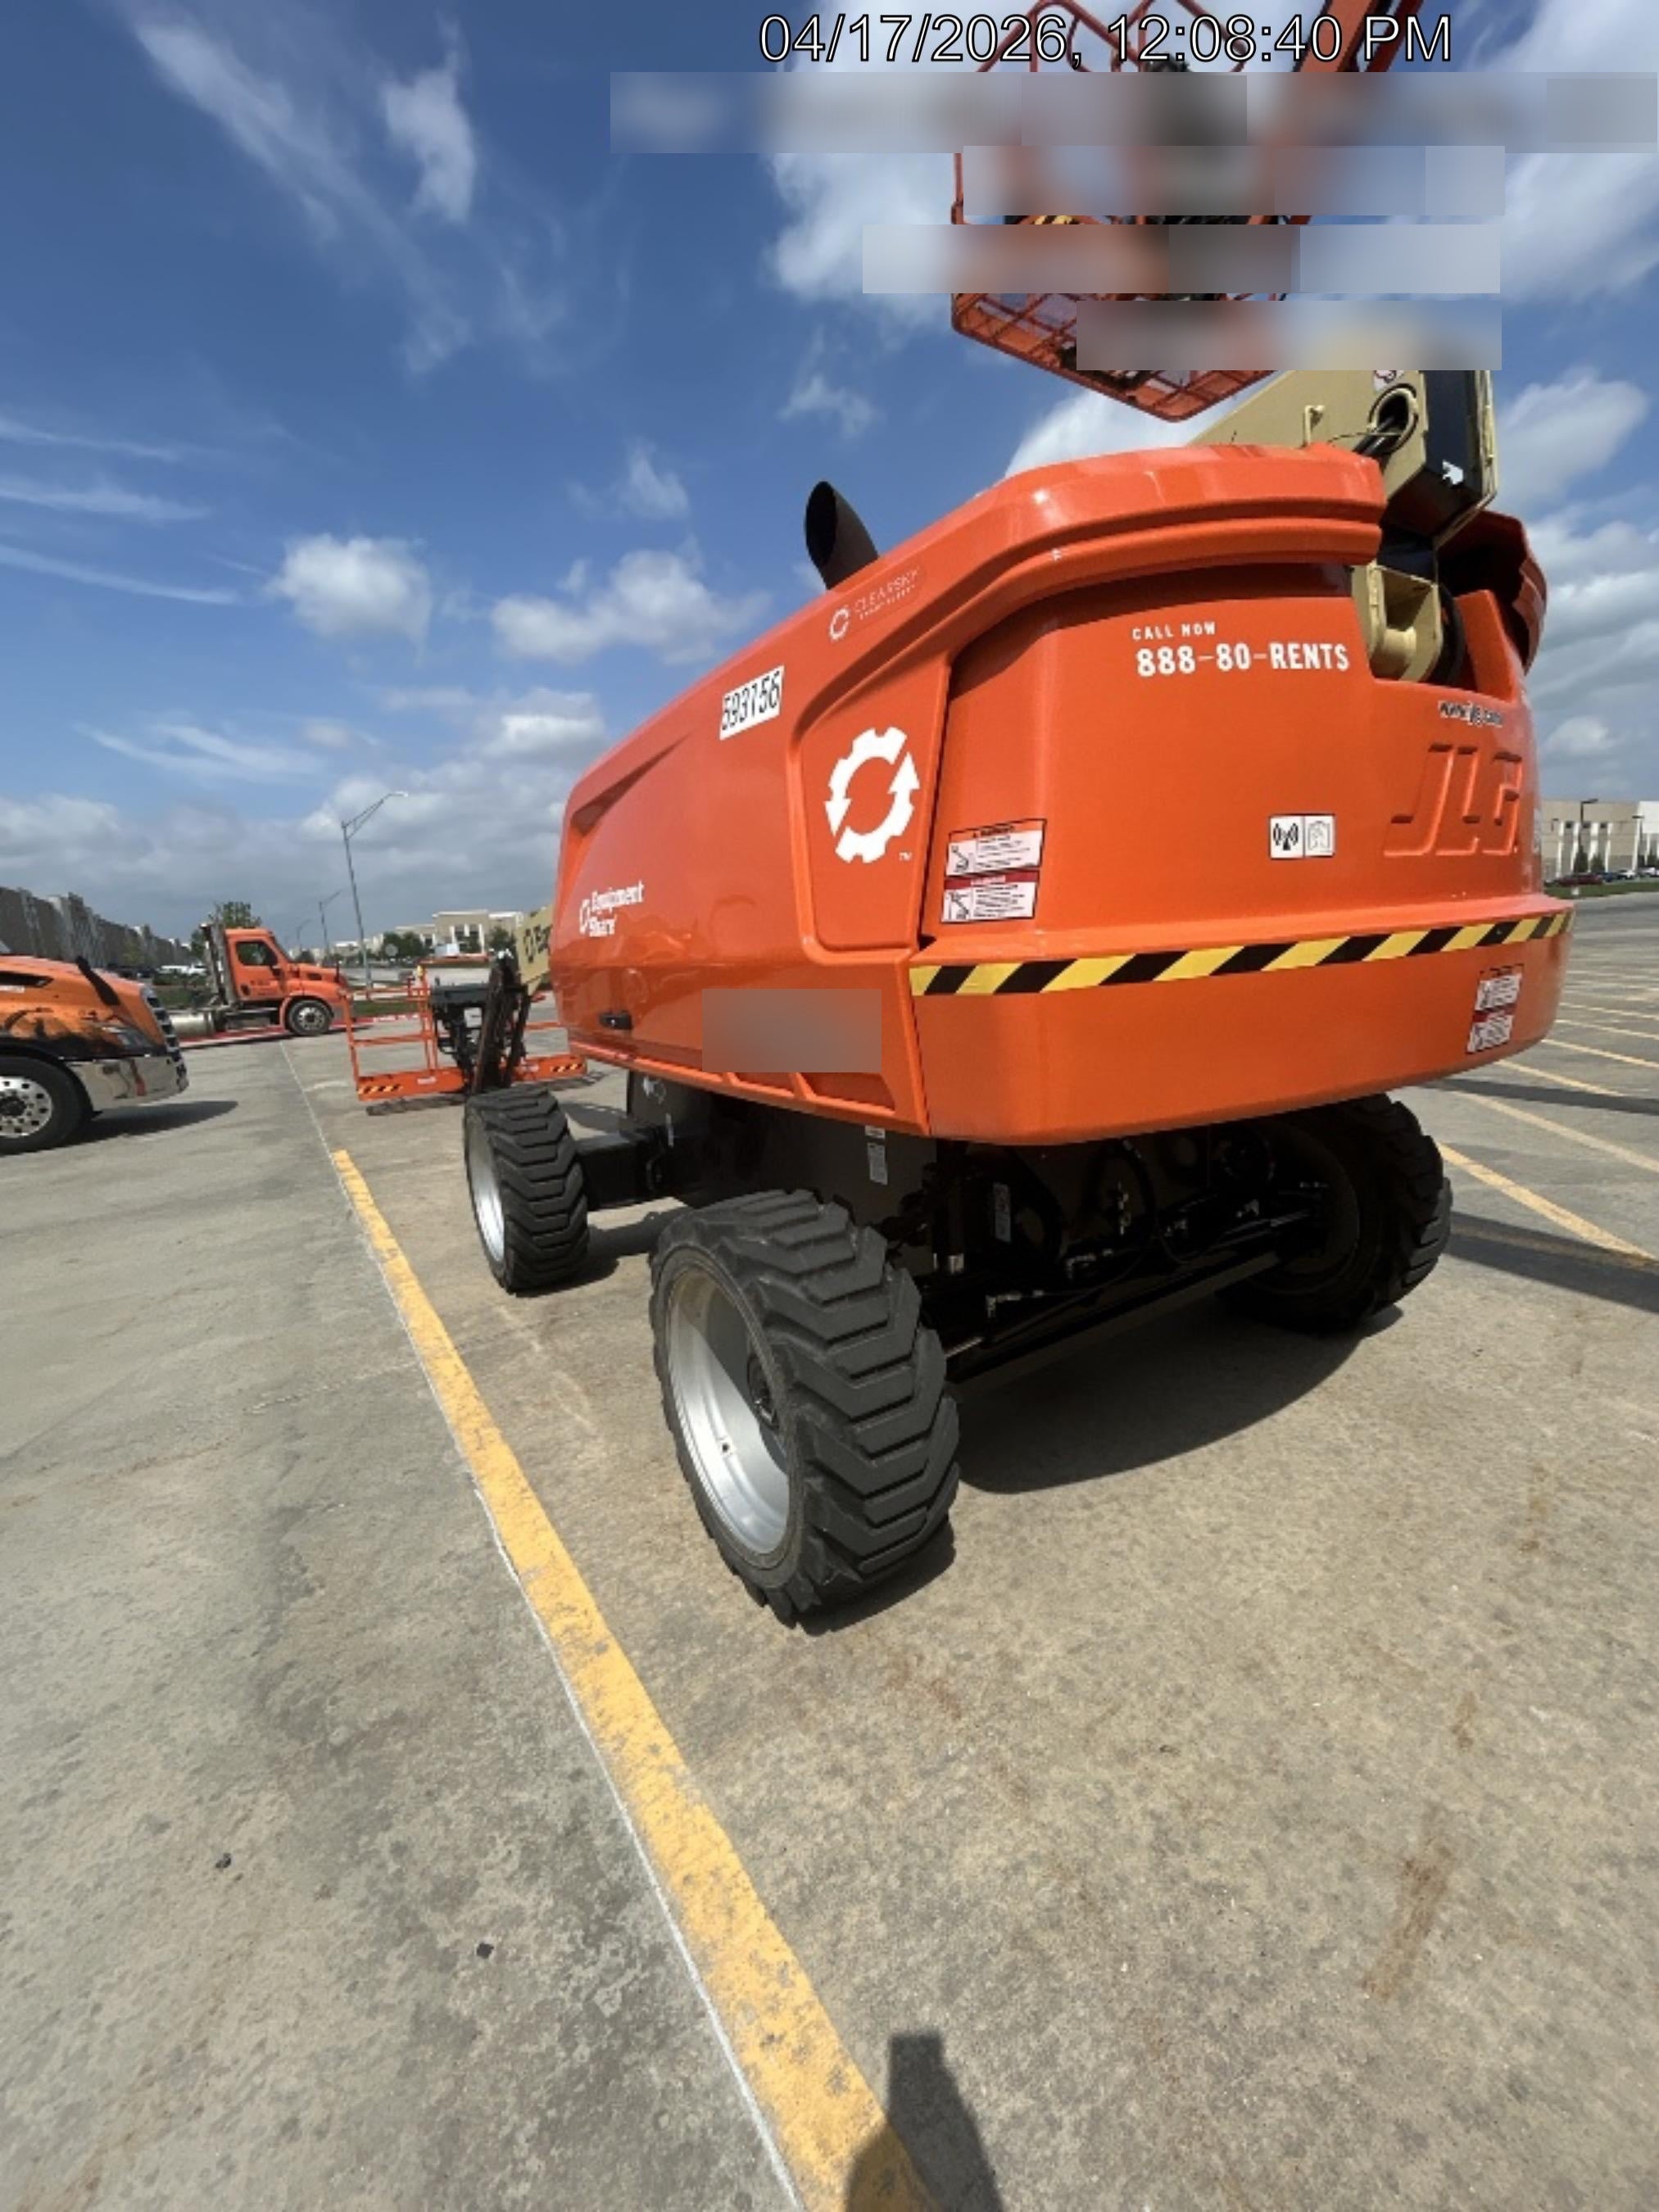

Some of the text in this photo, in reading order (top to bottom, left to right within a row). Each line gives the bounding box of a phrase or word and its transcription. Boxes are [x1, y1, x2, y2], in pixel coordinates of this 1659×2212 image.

[1132, 621, 1217, 641] CALL NOW
[1135, 641, 1350, 678] 888-80-RENTS
[722, 670, 780, 731] 593156
